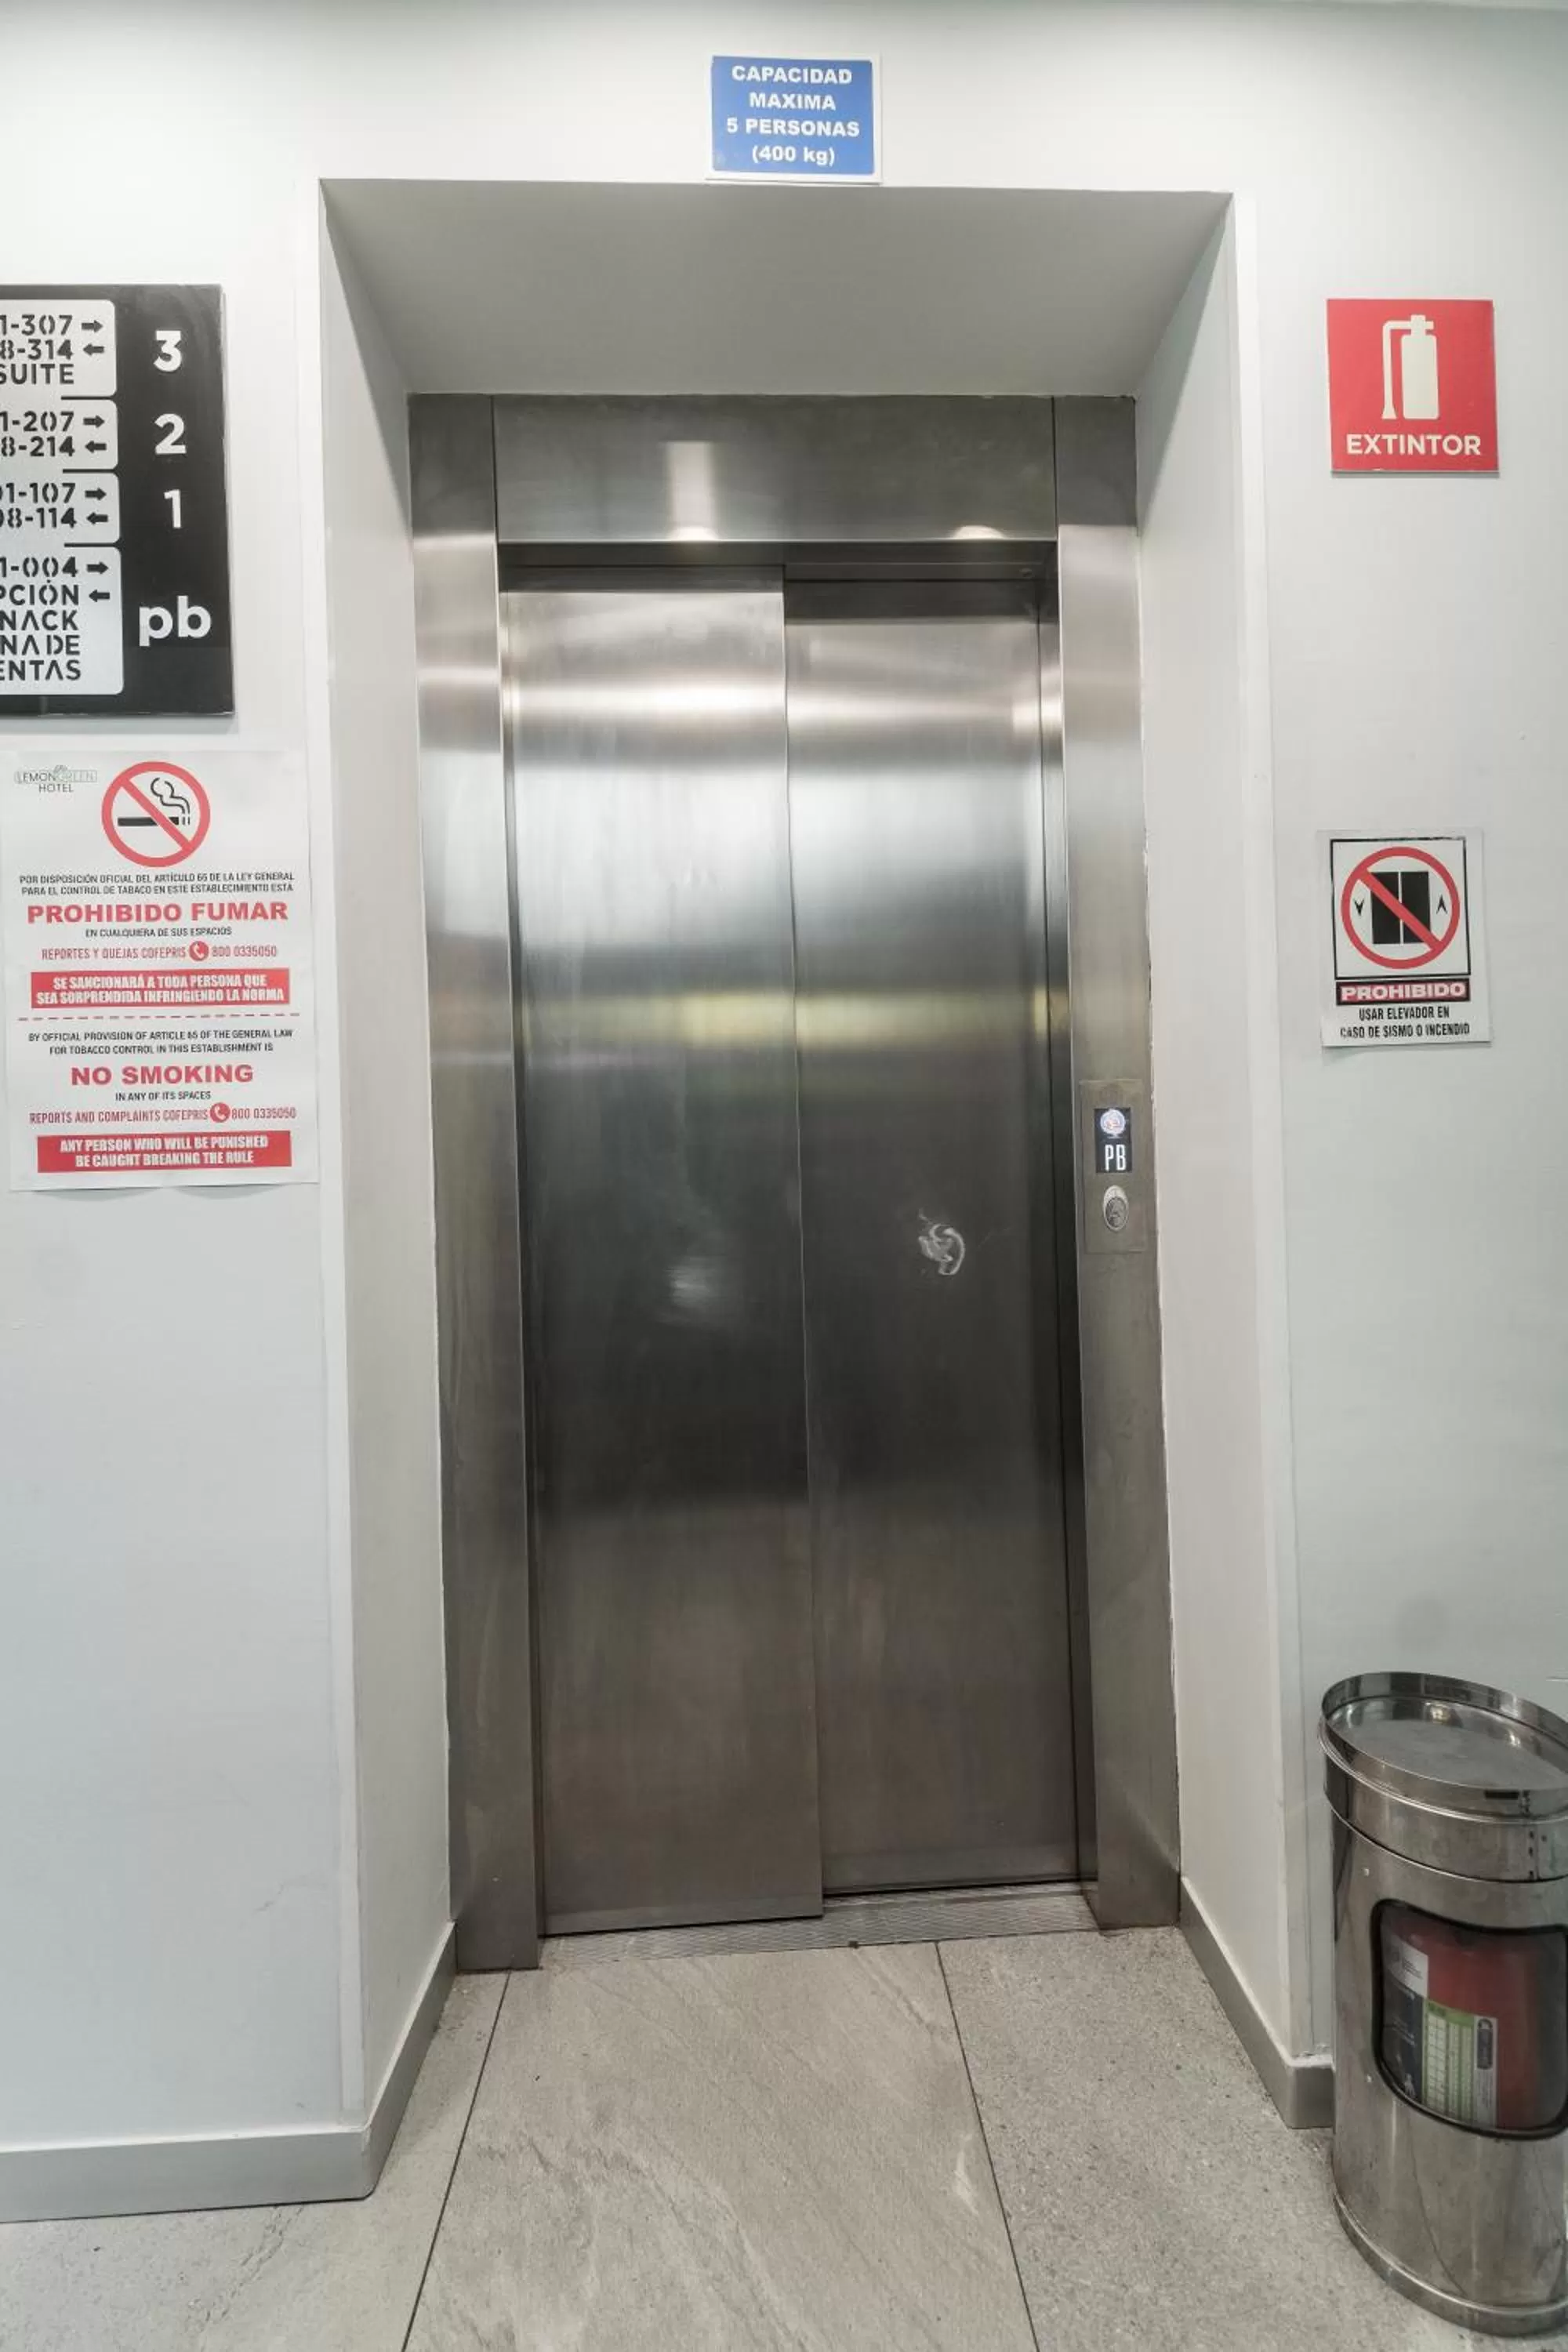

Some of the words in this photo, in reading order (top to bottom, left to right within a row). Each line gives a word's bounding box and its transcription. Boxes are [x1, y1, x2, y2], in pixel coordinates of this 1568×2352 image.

[731, 66, 852, 84] CAPACIDAD
[750, 92, 836, 111] MAXIMA
[727, 118, 739, 134] 5
[746, 118, 860, 136] PERSONAS
[753, 145, 796, 163] (400
[804, 147, 835, 166] kg)
[0, 339, 73, 360] 8-314
[154, 330, 182, 372] 3
[155, 414, 186, 455] 2
[1, 436, 75, 456] 8-214
[1346, 434, 1481, 456] EXTINTOR
[0, 482, 75, 503] 1-107
[163, 489, 183, 528] 1
[0, 508, 77, 528] 8-114
[138, 596, 212, 647] pb
[47, 635, 80, 655] DE
[38, 784, 74, 793] HOTEL
[20, 876, 38, 884] POR
[41, 873, 97, 884] DISPOSICIÓN
[136, 874, 151, 883] DEL
[154, 873, 195, 882] ARTÍCULO
[223, 873, 234, 881] LA
[236, 873, 252, 881] LEY
[255, 872, 294, 880] GENERAL
[22, 887, 46, 895] PARA
[103, 886, 114, 895] DE
[118, 886, 151, 895] TABACO
[191, 884, 269, 893] ESTABLECIMIENTO
[27, 903, 182, 924] PROHIBIDO
[191, 902, 289, 920] FUMAR
[100, 928, 156, 937] CUALQUIERA
[171, 927, 188, 936] SUS
[191, 927, 232, 936] ESPACIOS
[42, 948, 90, 960] REPORTES
[93, 949, 99, 959] Y
[101, 948, 139, 959] QUEJAS
[140, 946, 187, 958] COFEPRIS
[53, 977, 68, 989] SE
[147, 977, 155, 988] A
[158, 975, 188, 988] TODA
[191, 975, 241, 987] PERSONA
[244, 975, 267, 986] QUE
[37, 992, 58, 1004] SEA
[60, 991, 142, 1004] SORPRENDIDA
[144, 989, 223, 1003] INFRINGIENDO
[226, 989, 239, 1001] LA
[241, 989, 284, 1000] NORMA
[1340, 982, 1466, 1001] PROHIBIDO
[1359, 1008, 1384, 1020] USAR
[1388, 1007, 1433, 1019] ELEVADOR
[1437, 1007, 1449, 1018] EN
[85, 1032, 132, 1040] PROVISION
[150, 1031, 185, 1040] ARTICLE
[232, 1029, 272, 1038] GENERAL
[1341, 1027, 1365, 1038] CASO
[1368, 1026, 1380, 1037] DE
[1383, 1025, 1413, 1037] SISMO
[1416, 1025, 1423, 1036] O
[1426, 1023, 1470, 1035] INCENDIO
[191, 1043, 262, 1052] ESTABLISHMENT
[71, 1067, 111, 1085] NO
[122, 1064, 254, 1083] SMOKING
[178, 1091, 211, 1099] SPACES
[30, 1112, 72, 1123] REPORTS
[75, 1111, 94, 1122] AND
[98, 1110, 160, 1122] COMPLAINTS
[163, 1109, 209, 1120] COFEPRIS
[231, 1109, 250, 1119] 800
[60, 1140, 82, 1152] ANY
[85, 1139, 132, 1151] PERSON
[135, 1138, 162, 1150] WHO
[164, 1137, 191, 1149] WILL
[194, 1136, 209, 1149] BE
[211, 1135, 269, 1148] PUNISHED
[75, 1155, 90, 1167] BE
[93, 1154, 141, 1166] CAUGHT
[143, 1152, 201, 1166] BREAKING
[202, 1152, 223, 1163] THE
[226, 1151, 254, 1163] RULE
[1105, 1144, 1127, 1171] PB
